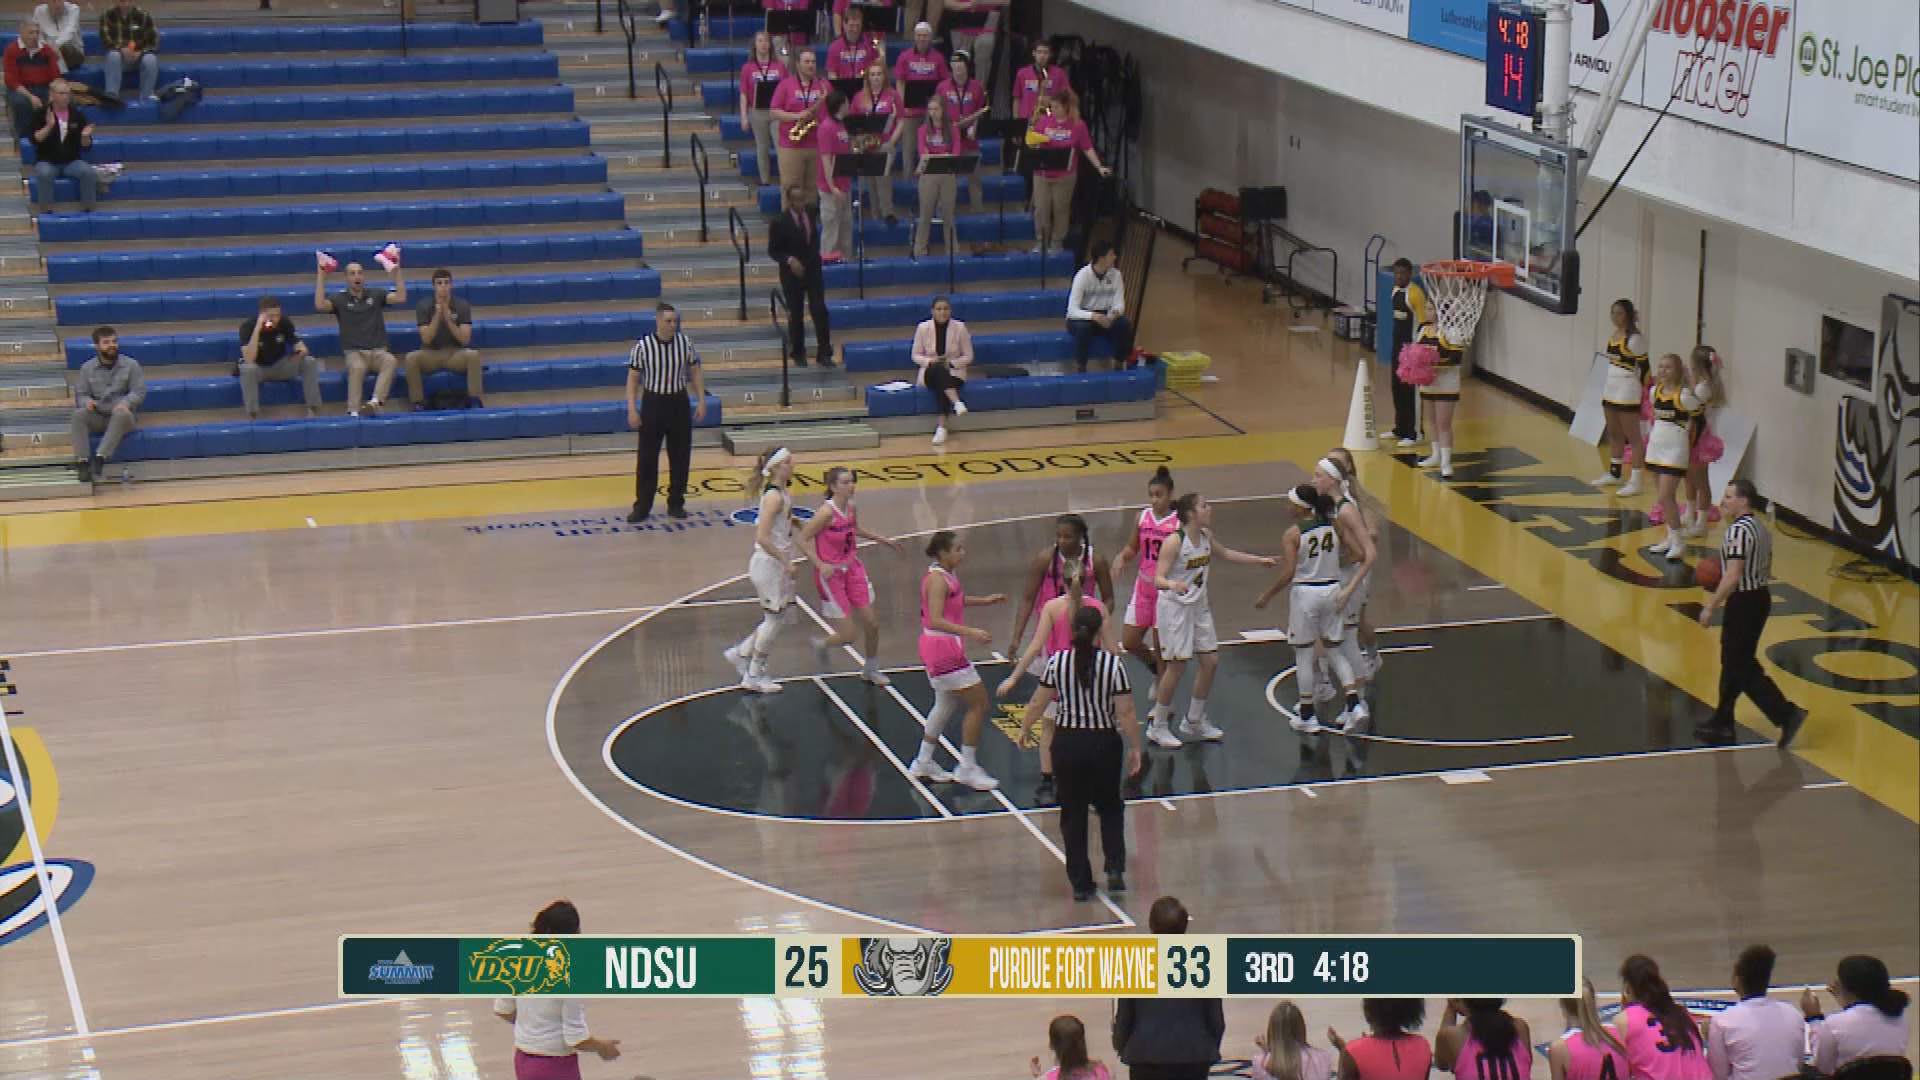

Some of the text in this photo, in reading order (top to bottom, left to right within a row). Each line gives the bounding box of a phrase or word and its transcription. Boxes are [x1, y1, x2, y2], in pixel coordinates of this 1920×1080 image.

[1503, 52, 1525, 102] 14
[1671, 37, 1759, 118] ride!
[1820, 37, 1842, 80] St.
[1846, 44, 1889, 89] Joe
[1308, 531, 1335, 558] 24
